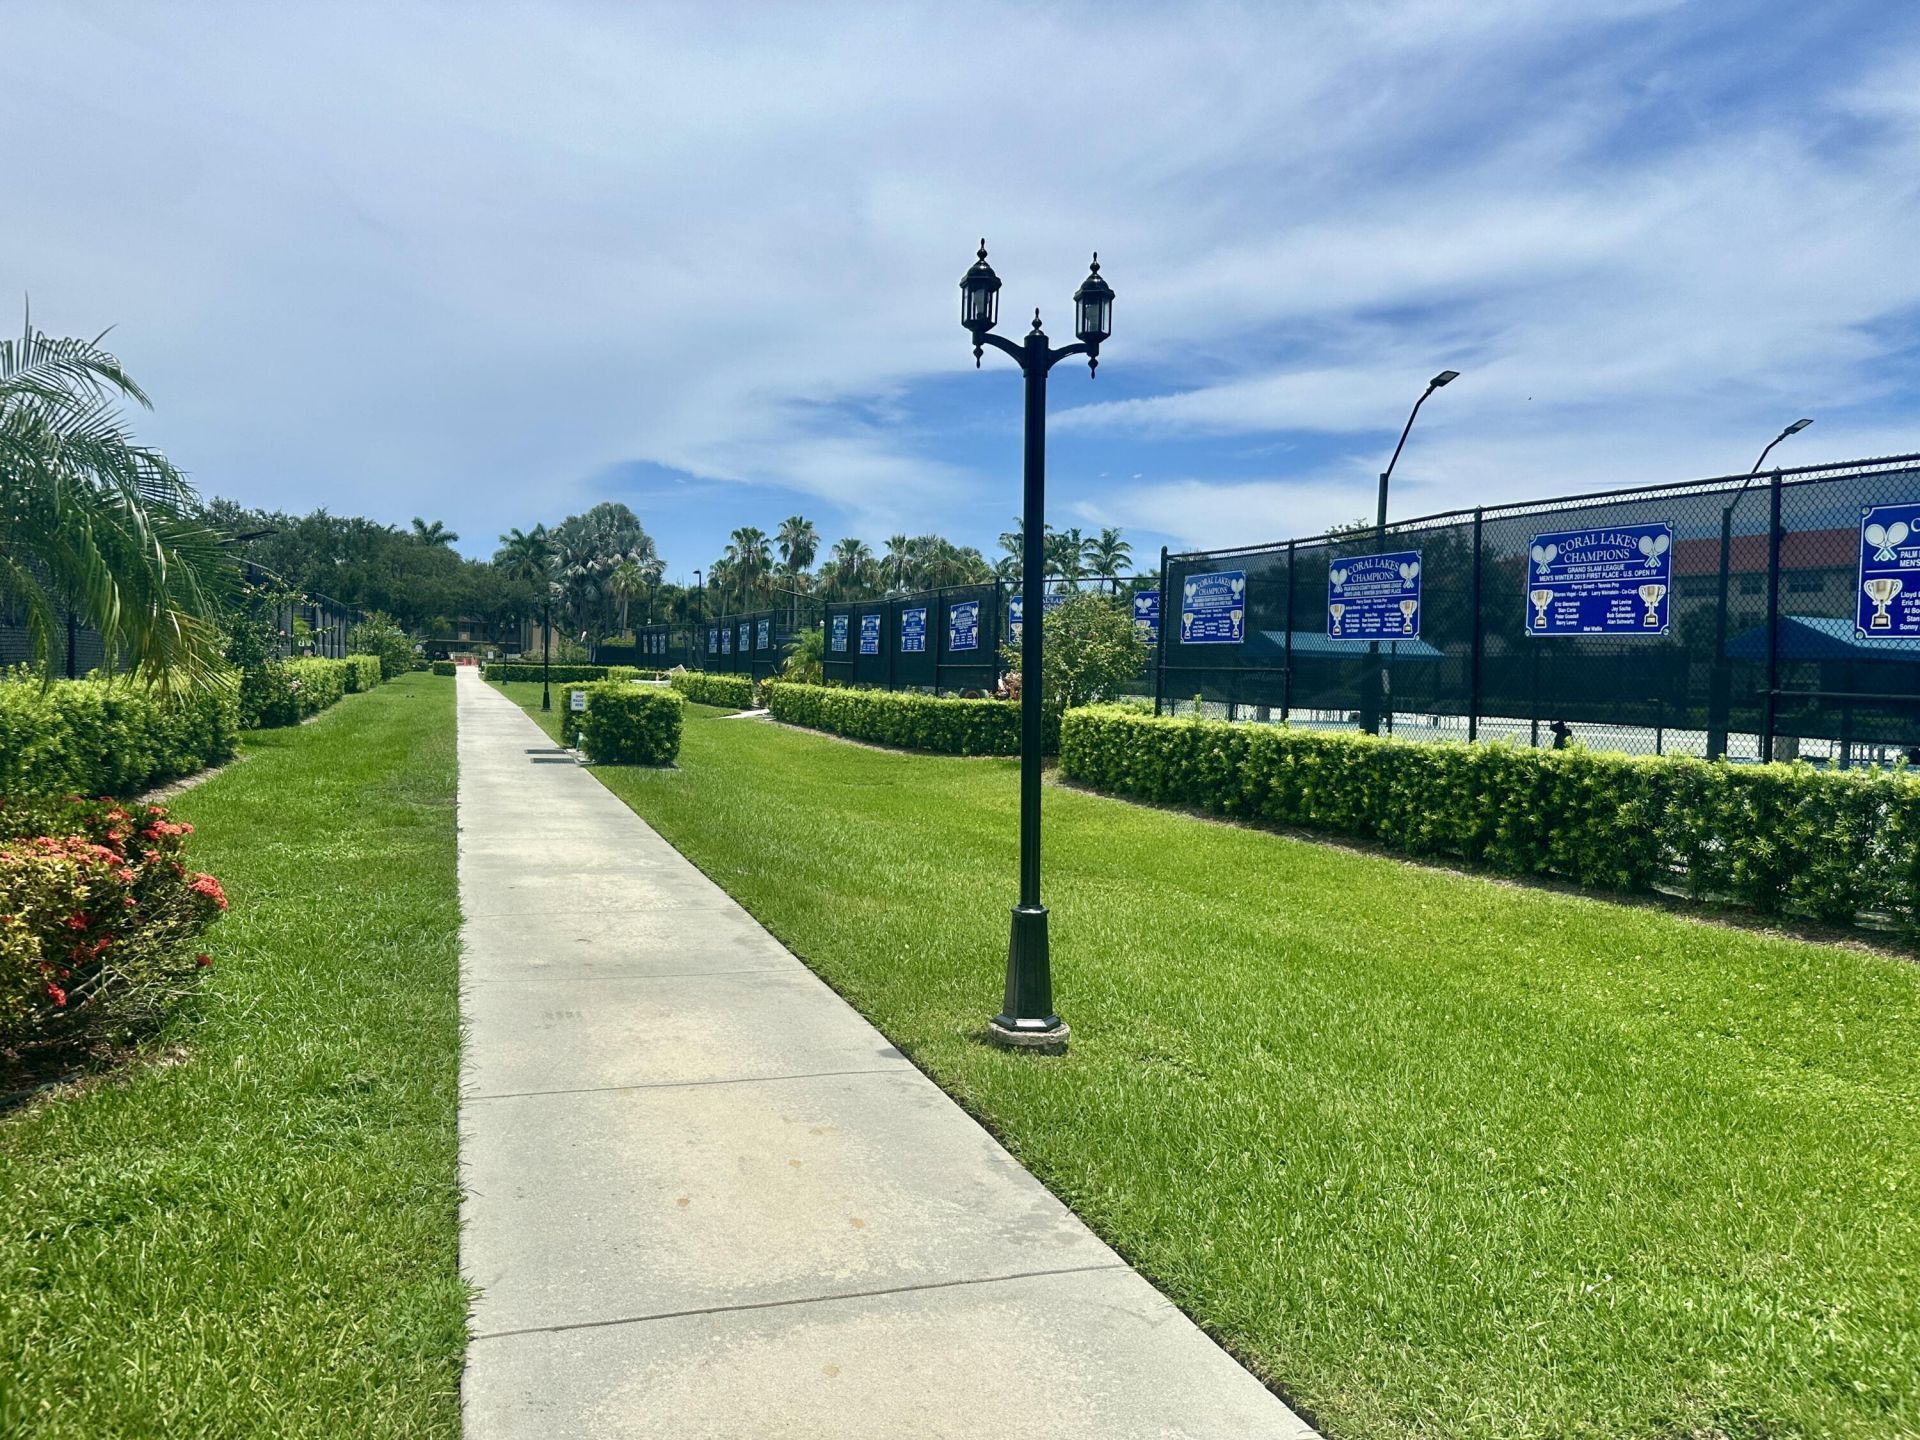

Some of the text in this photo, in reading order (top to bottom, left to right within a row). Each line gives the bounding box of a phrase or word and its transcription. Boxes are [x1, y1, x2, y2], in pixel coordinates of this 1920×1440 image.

[1558, 532, 1639, 555] CORAL LAKES
[1564, 548, 1630, 564] CHAMPIONS
[1900, 550, 1918, 559] PALM
[1347, 558, 1400, 576] CORAL LAKES
[1567, 563, 1625, 574] GRAND SLAM LEAGUE
[1351, 571, 1395, 583] CHAMPIONS
[1554, 573, 1574, 581] WINTER
[1586, 572, 1601, 580] FIRST
[1601, 571, 1620, 579] PLACE
[1634, 569, 1650, 577] OPEN
[1196, 575, 1231, 590] CORAL LAKES
[1198, 586, 1228, 596] CHAMPIONS
[1900, 591, 1917, 599] Lloyd
